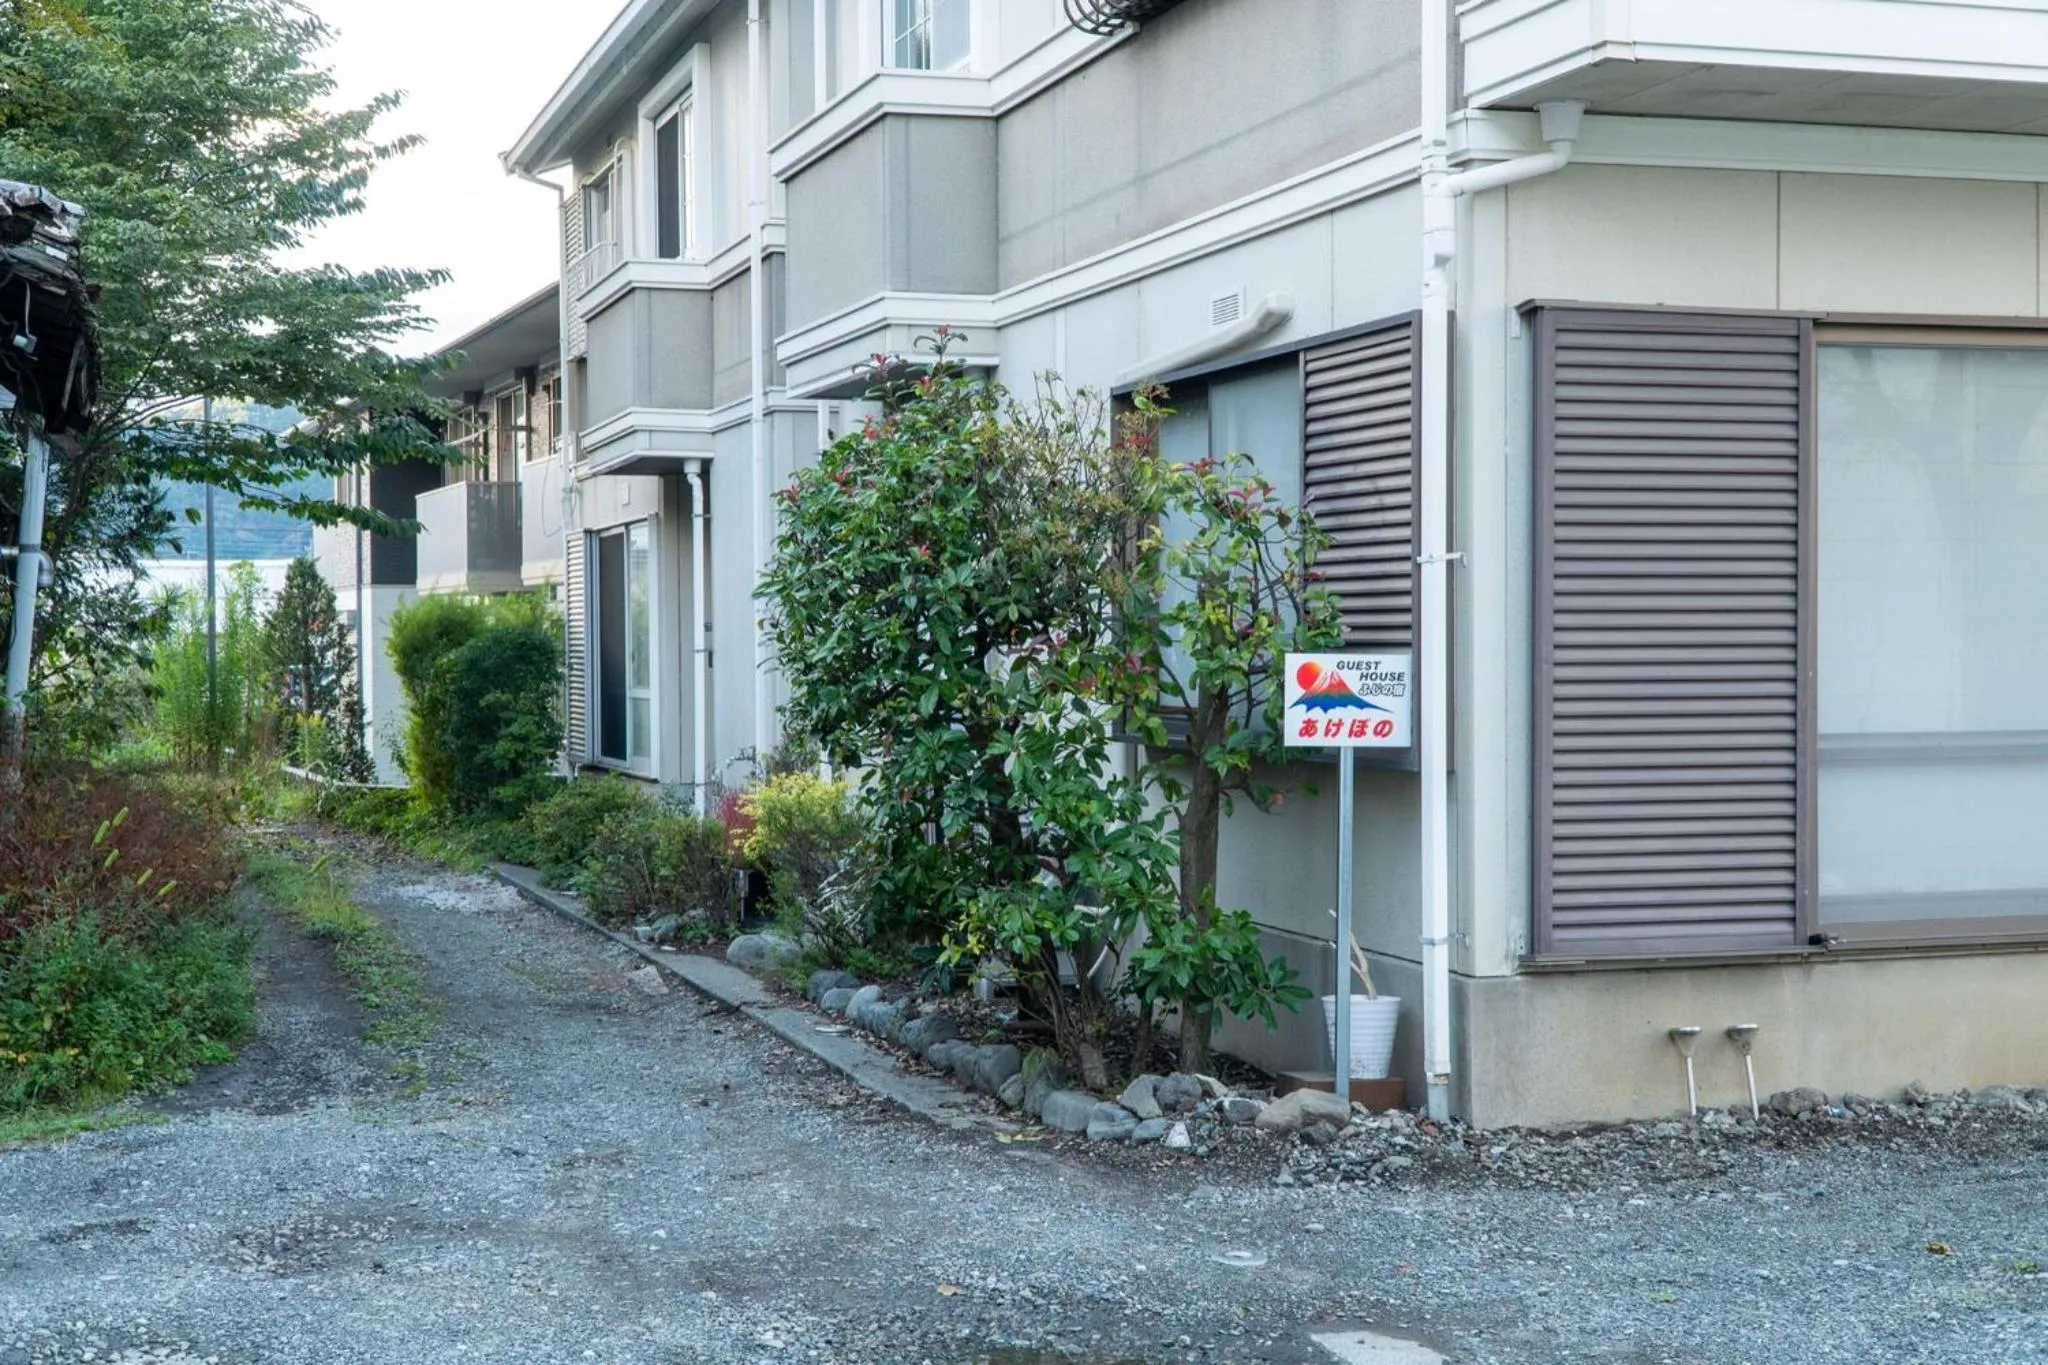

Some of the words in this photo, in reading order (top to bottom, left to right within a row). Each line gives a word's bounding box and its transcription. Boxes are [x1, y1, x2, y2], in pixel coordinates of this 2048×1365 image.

[1336, 660, 1381, 671] GUEST
[1359, 671, 1405, 682] HOUSE
[1298, 717, 1394, 739] あけぼの
